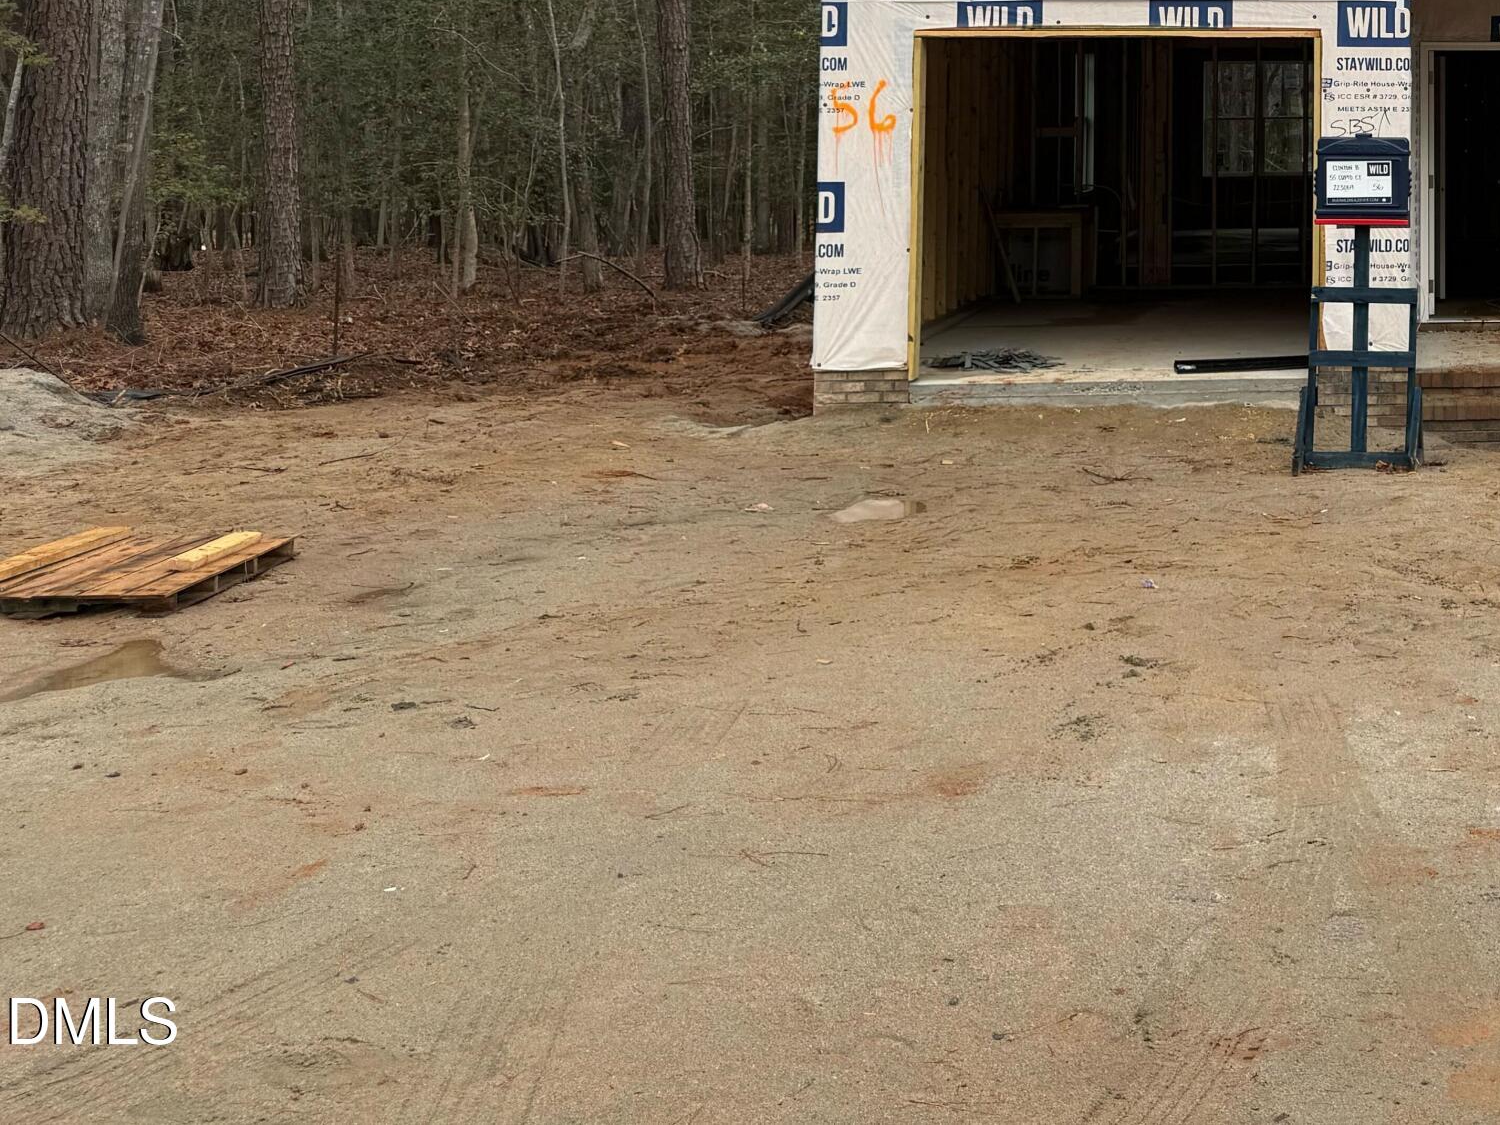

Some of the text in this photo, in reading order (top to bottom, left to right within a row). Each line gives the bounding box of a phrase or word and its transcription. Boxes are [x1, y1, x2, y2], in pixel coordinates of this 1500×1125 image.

[966, 6, 1034, 27] WILD
[1158, 6, 1224, 27] WILD
[1346, 7, 1411, 38] WILD
[830, 78, 898, 135] 56
[1368, 164, 1389, 175] WILD
[843, 267, 862, 275] LWE
